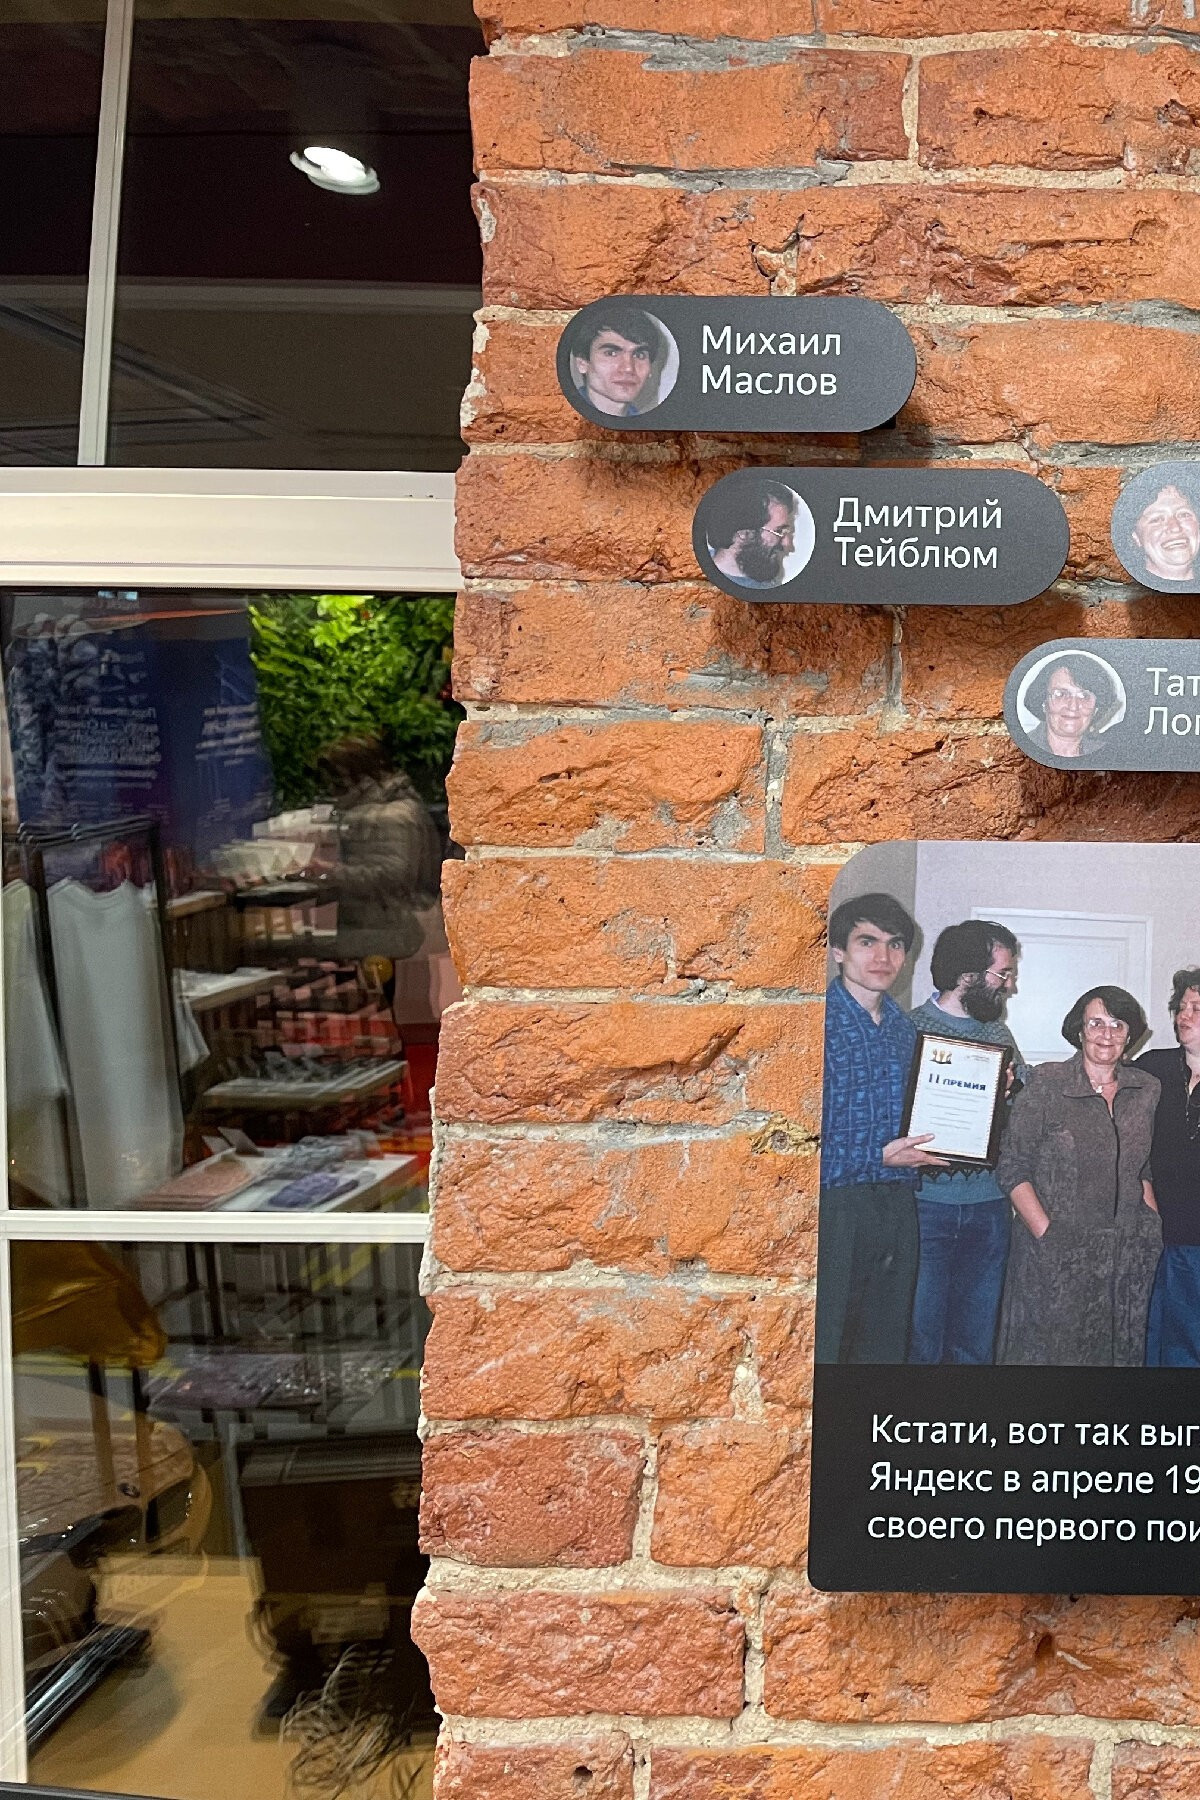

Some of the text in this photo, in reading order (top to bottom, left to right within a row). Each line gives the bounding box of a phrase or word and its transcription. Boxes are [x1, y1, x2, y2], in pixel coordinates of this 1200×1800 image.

[702, 324, 842, 356] Михаил
[702, 364, 838, 396] Маслов
[833, 497, 1003, 533] Дмитрий
[833, 535, 999, 570] Тейблюм
[942, 1078, 987, 1091] ПРЕМИЯ
[872, 1414, 998, 1448] Кстати,
[1008, 1422, 1065, 1445] вот
[1074, 1423, 1130, 1446] так
[869, 1461, 993, 1497] Яндекс
[1003, 1470, 1021, 1492] в
[1031, 1470, 1154, 1500] апреле
[867, 1516, 985, 1540] своего
[995, 1517, 1136, 1547] первого
